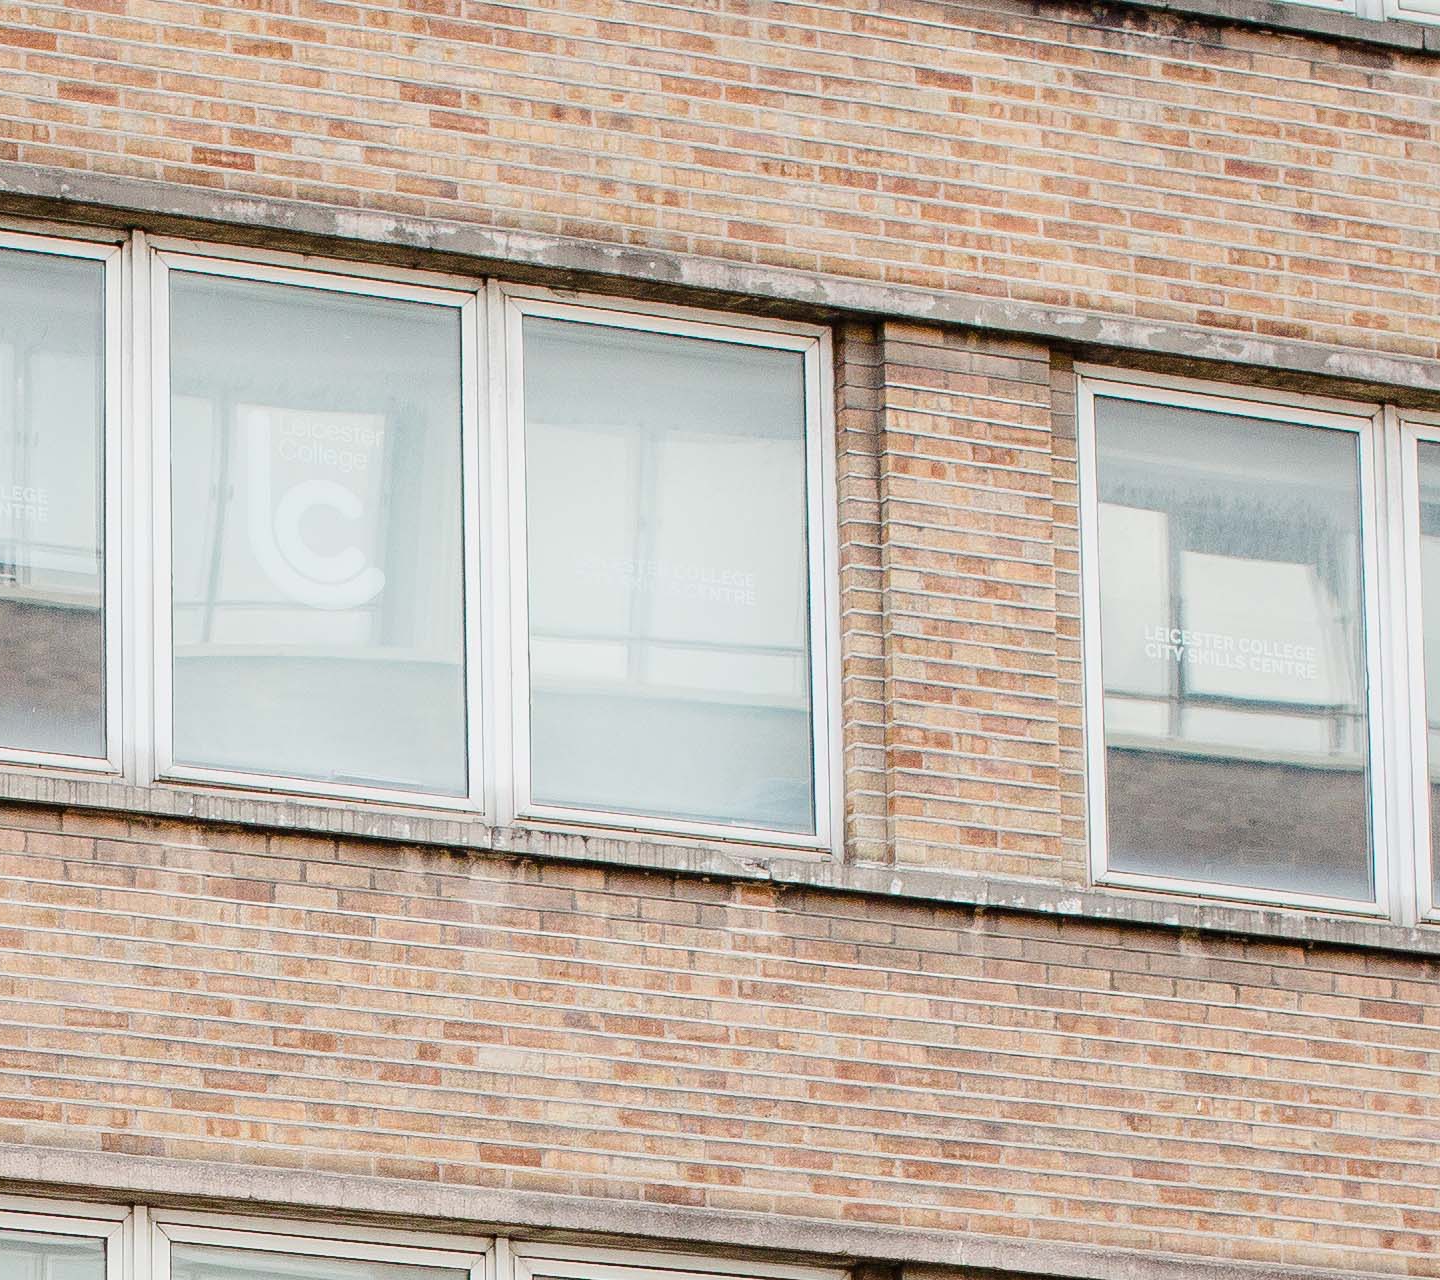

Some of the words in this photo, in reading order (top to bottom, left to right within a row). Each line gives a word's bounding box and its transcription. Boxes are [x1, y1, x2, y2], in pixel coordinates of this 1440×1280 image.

[1144, 624, 1234, 649] LEICESTER
[1239, 638, 1316, 661] COLLEGE
[1145, 643, 1185, 662] CITY
[1188, 649, 1249, 671] SKILLS
[1250, 657, 1317, 680] CENTRE
